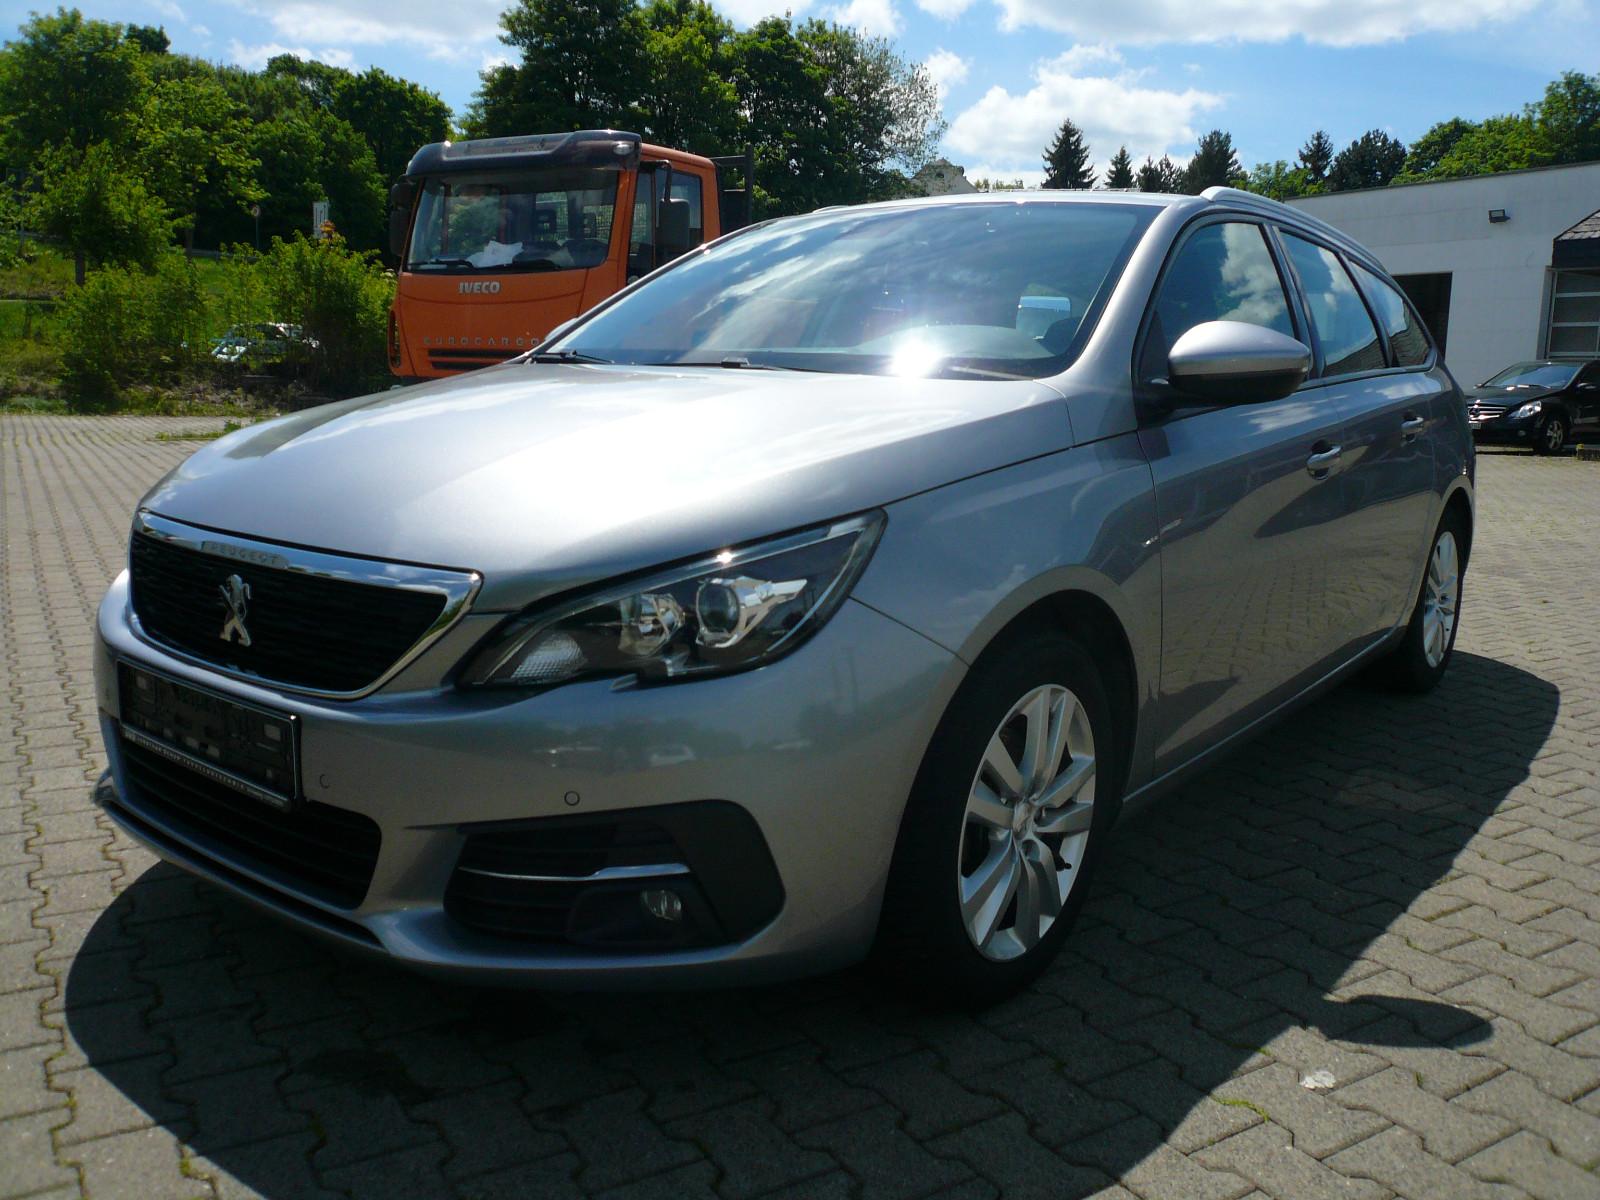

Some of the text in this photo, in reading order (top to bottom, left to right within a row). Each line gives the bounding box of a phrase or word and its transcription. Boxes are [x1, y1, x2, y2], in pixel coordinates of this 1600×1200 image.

[458, 281, 501, 294] IVECO
[423, 336, 540, 346] EUROCARGO
[210, 541, 279, 565] PEUGEOT
